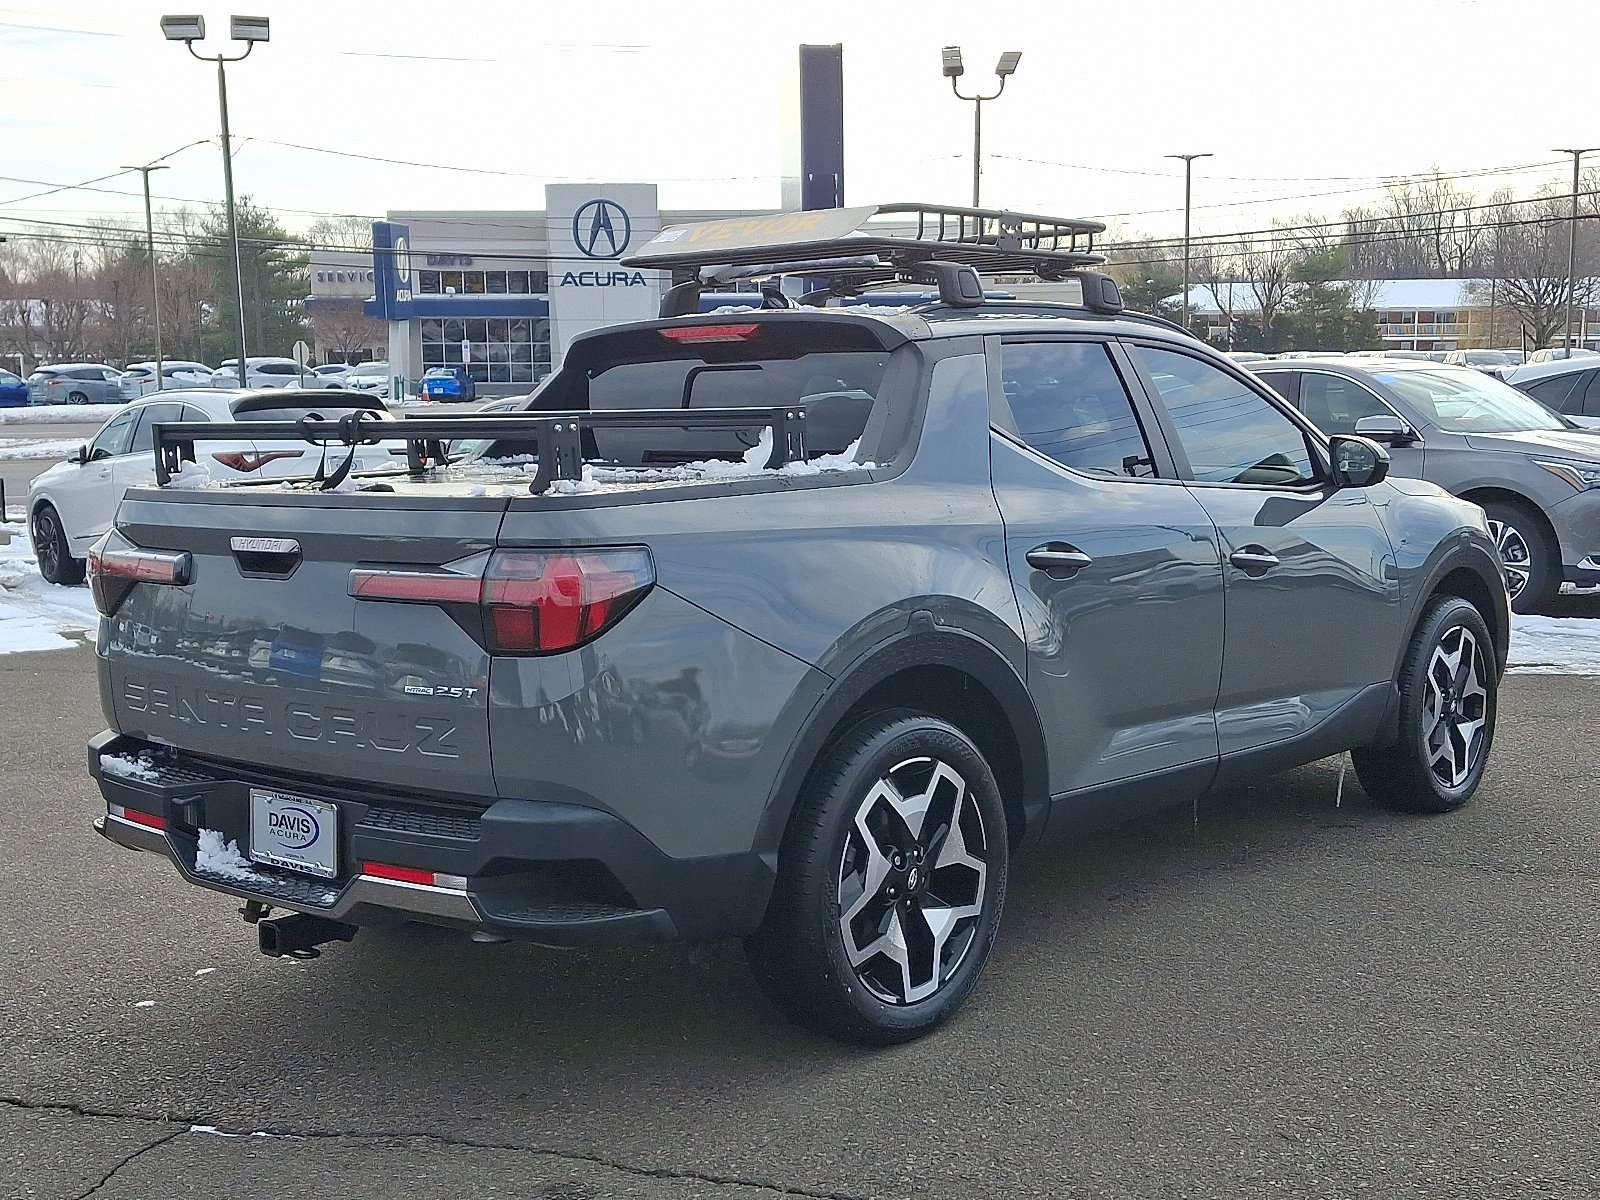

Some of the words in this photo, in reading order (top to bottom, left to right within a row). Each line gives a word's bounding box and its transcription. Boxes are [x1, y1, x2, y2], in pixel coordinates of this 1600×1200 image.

[426, 254, 473, 267] DAVIS
[316, 270, 375, 283] SERVIC
[559, 271, 647, 287] ACURA
[240, 538, 283, 551] HYUNDAI
[124, 682, 273, 735] SANTA
[286, 702, 460, 758] CRUZ
[268, 812, 311, 834] DAVIS
[269, 828, 307, 842] ACURA
[270, 858, 313, 872] DAVIS
